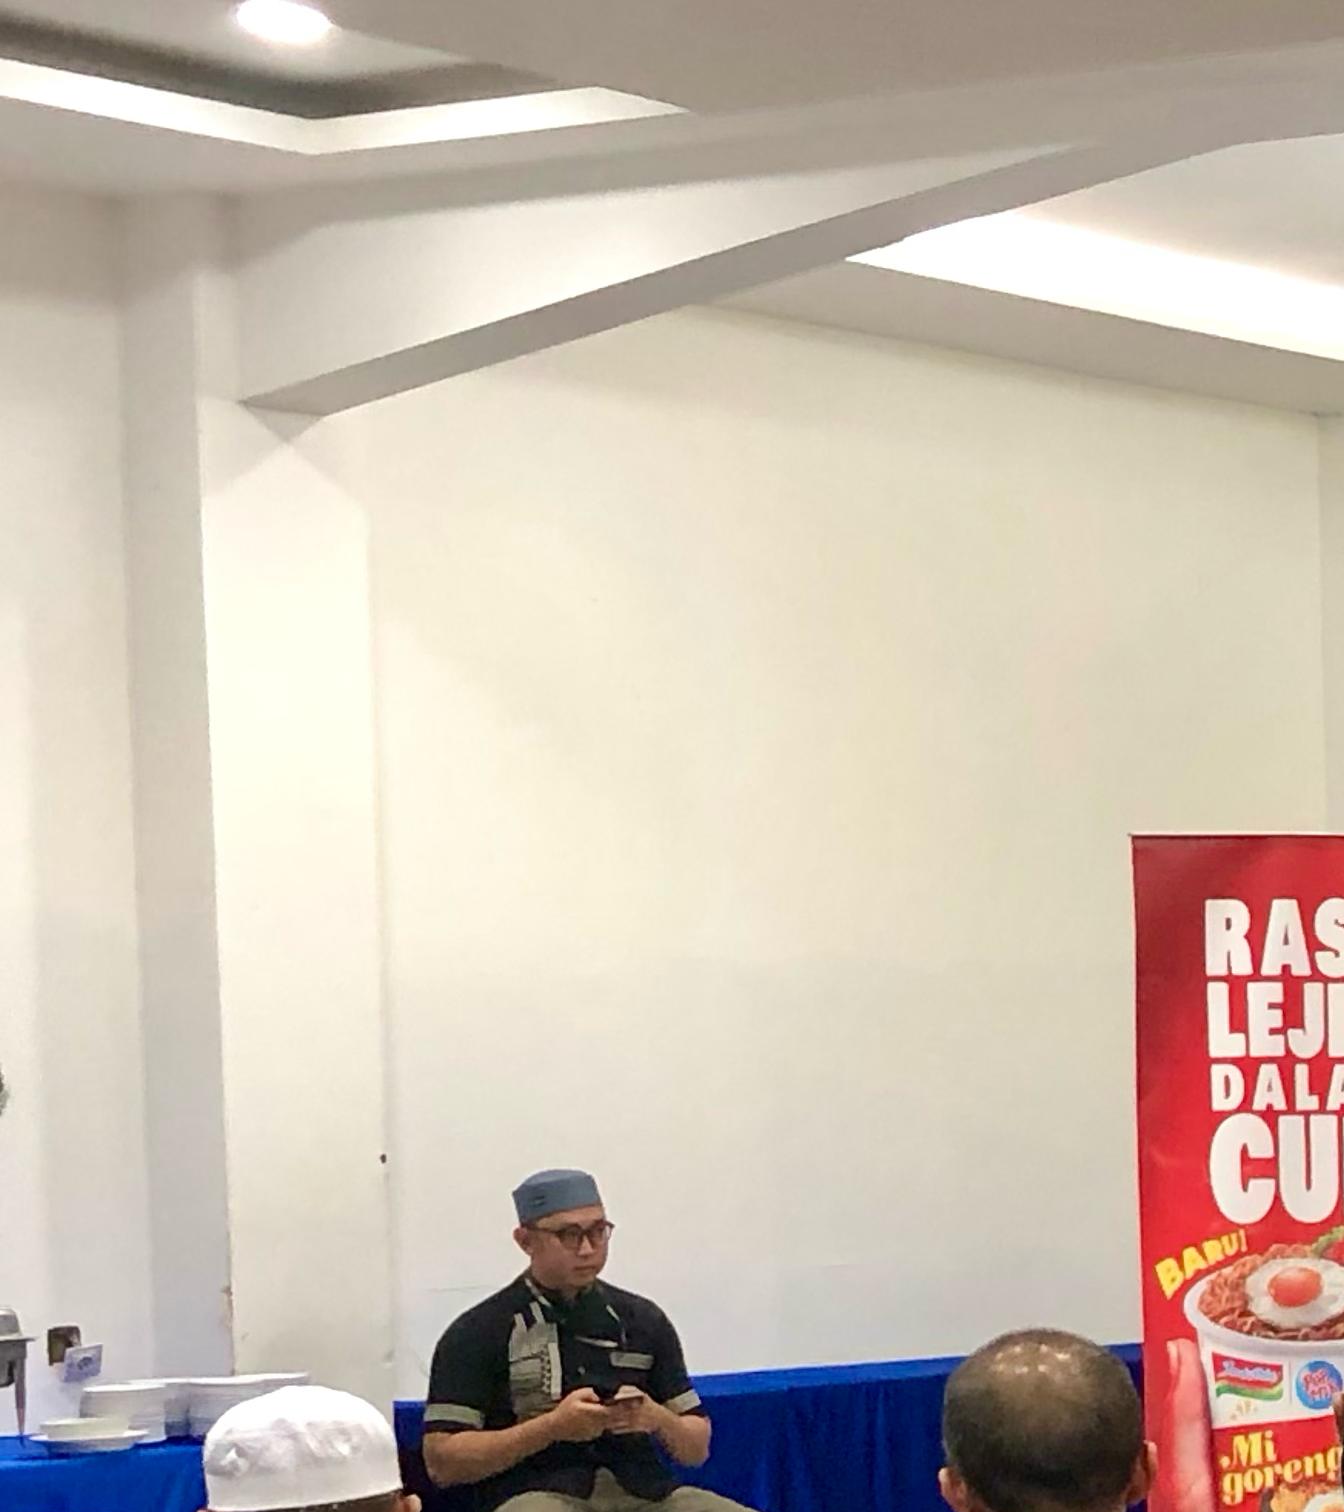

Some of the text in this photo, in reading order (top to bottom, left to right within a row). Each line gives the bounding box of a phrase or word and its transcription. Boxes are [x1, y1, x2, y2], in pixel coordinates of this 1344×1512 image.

[1153, 1229, 1247, 1300] BARU!
[1220, 1430, 1278, 1470] Mi
[1222, 1446, 1344, 1506] goreng
